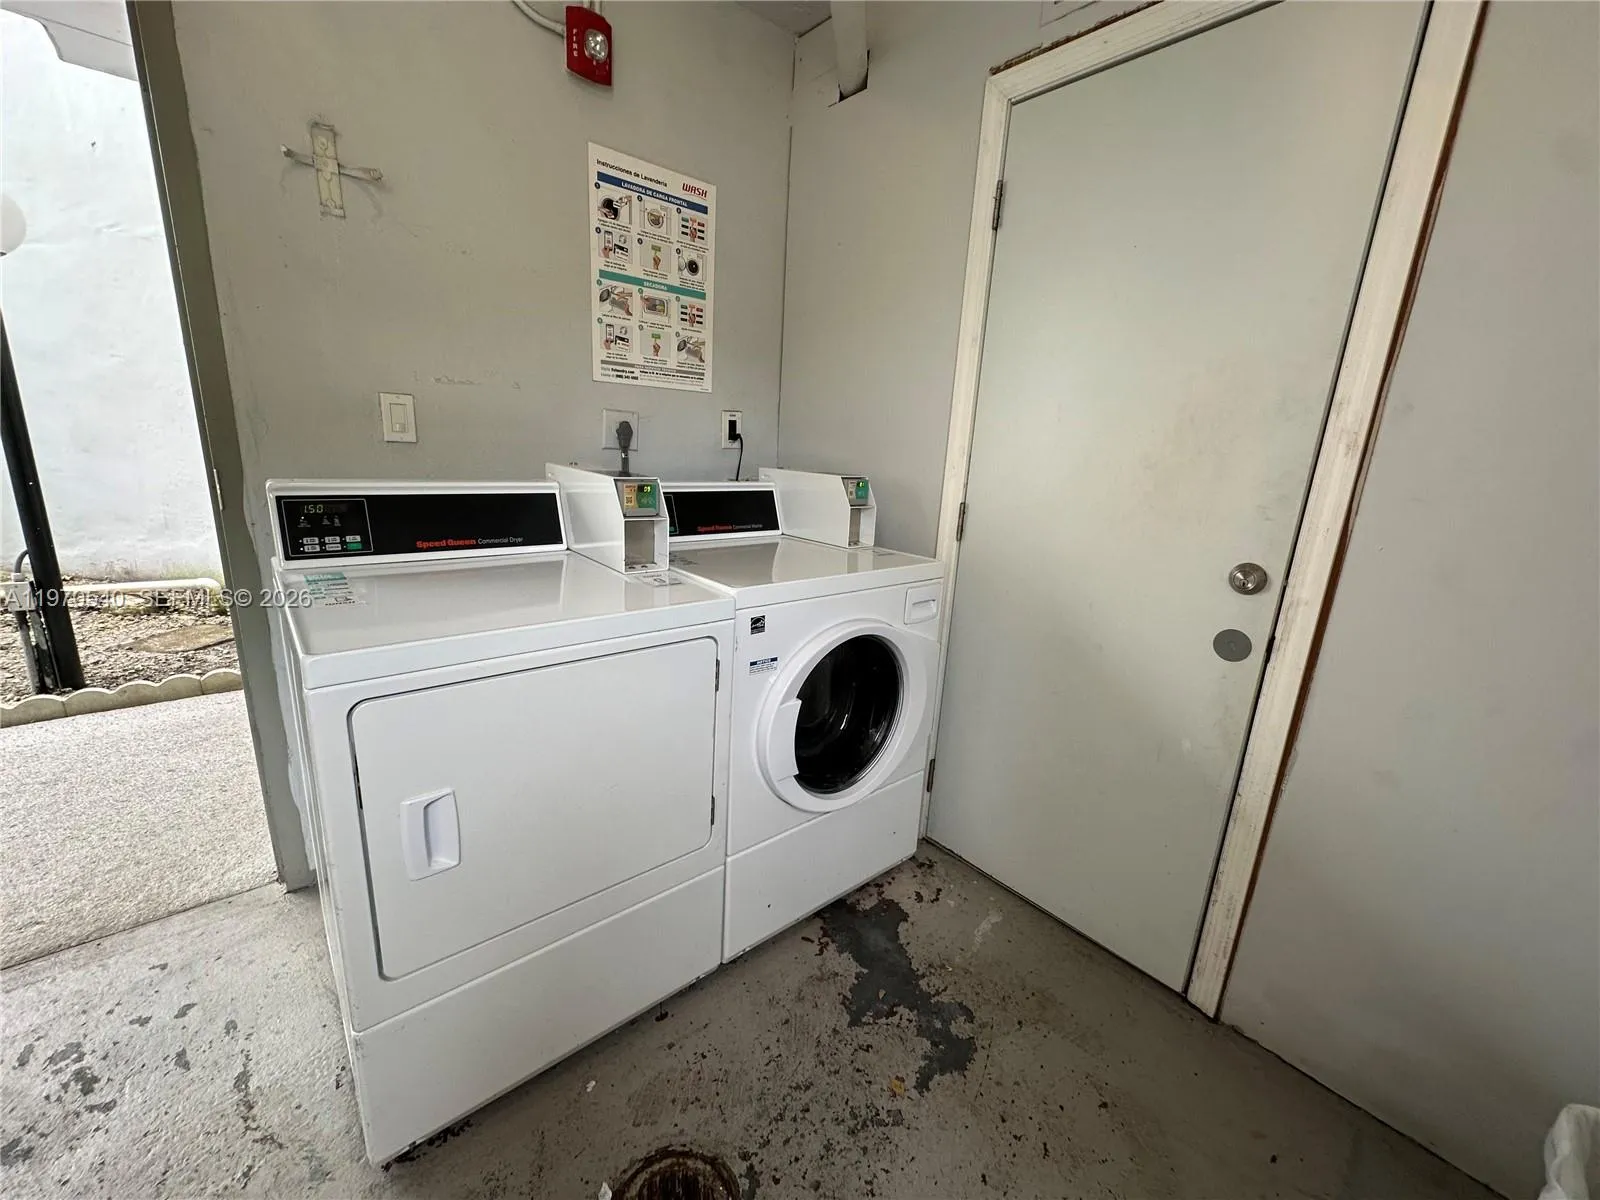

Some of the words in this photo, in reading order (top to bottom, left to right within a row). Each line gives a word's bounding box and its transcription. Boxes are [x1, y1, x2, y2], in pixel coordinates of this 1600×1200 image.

[596, 159, 632, 175] Instrucciones
[621, 182, 646, 194] LAVADORA
[652, 191, 668, 201] CARGA
[682, 182, 708, 198] WASH
[416, 540, 446, 549] Speed
[447, 538, 476, 546] Queen
[477, 536, 509, 544] Commercial
